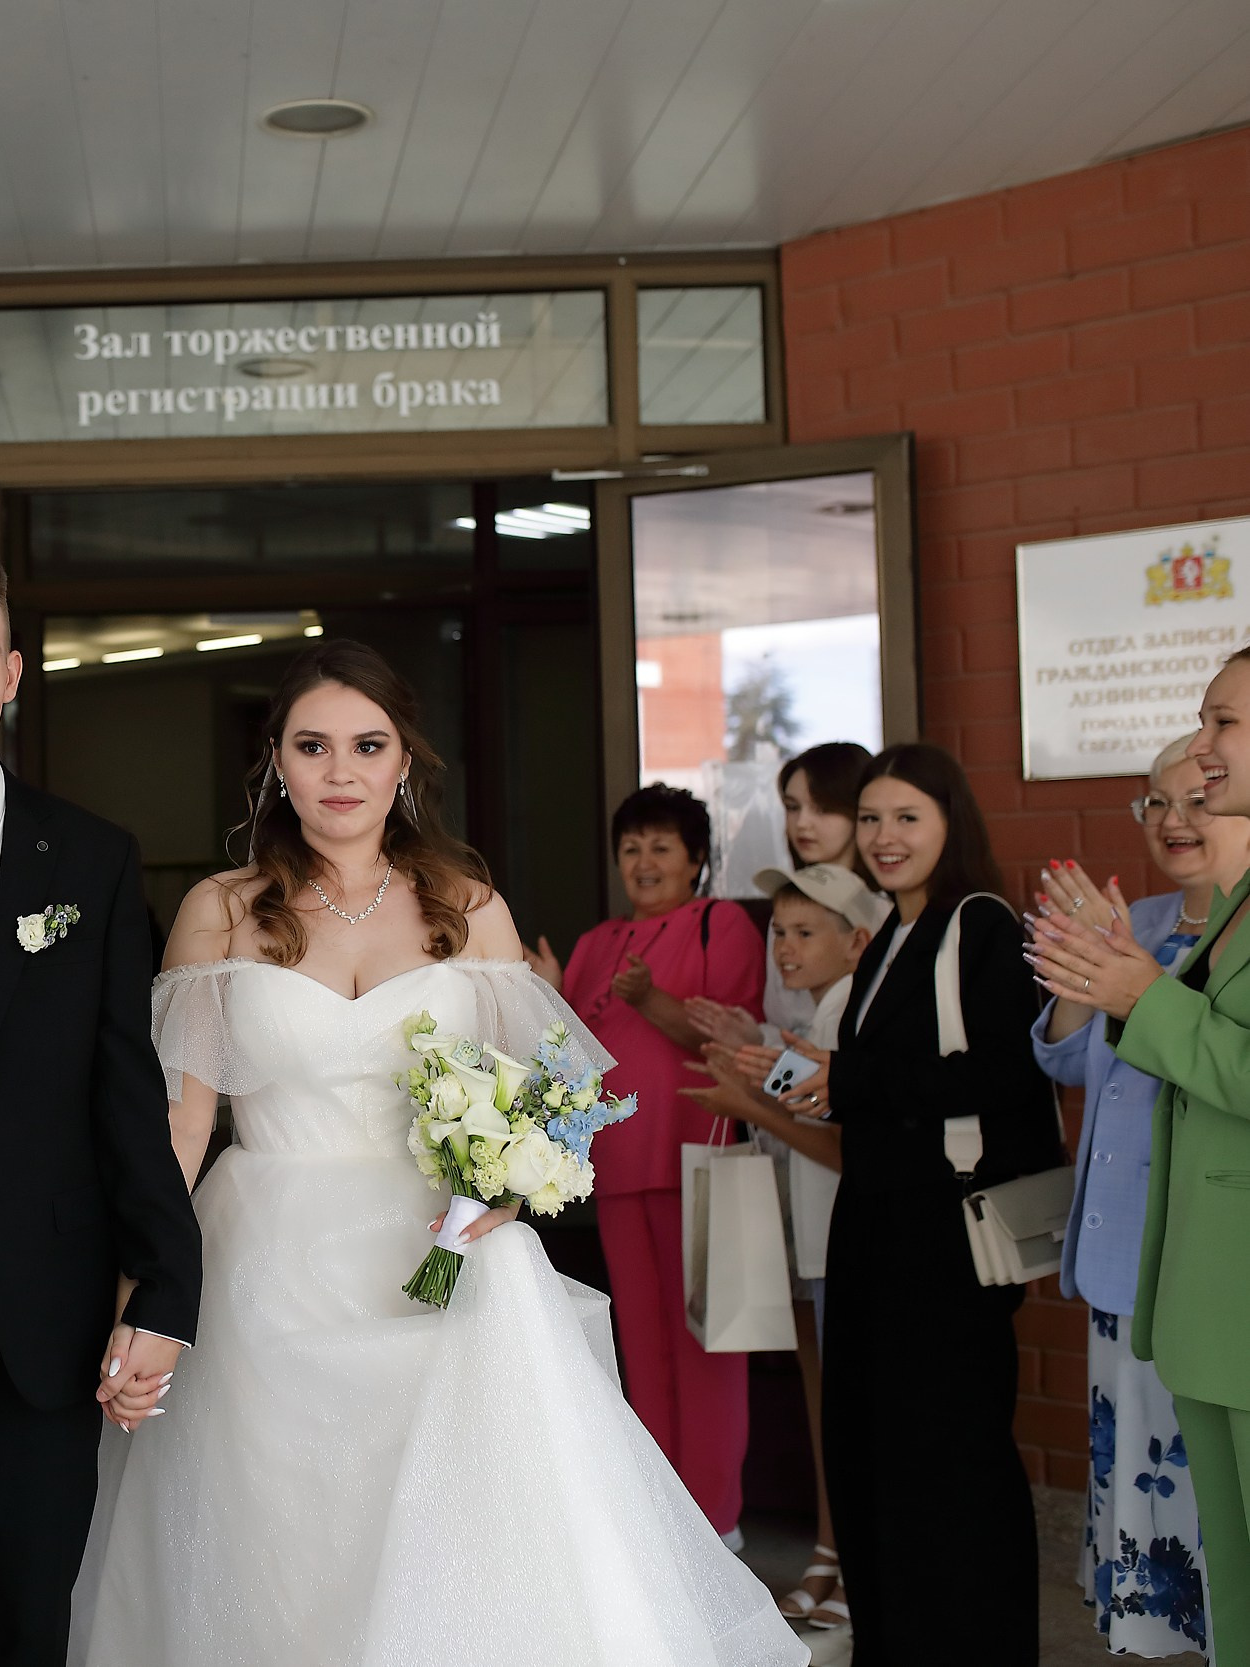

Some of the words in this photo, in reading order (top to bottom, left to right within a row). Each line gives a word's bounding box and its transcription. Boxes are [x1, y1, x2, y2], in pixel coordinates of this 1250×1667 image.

[73, 322, 151, 362] Зал
[162, 312, 502, 366] торжественной
[78, 380, 359, 427] регистрации
[371, 371, 502, 418] брака
[1143, 625, 1236, 651] ЗАПИСИ
[1036, 655, 1209, 686] ГРАЖДАНСКОГО
[1069, 682, 1206, 708] ЛЕНИНСКОГ
